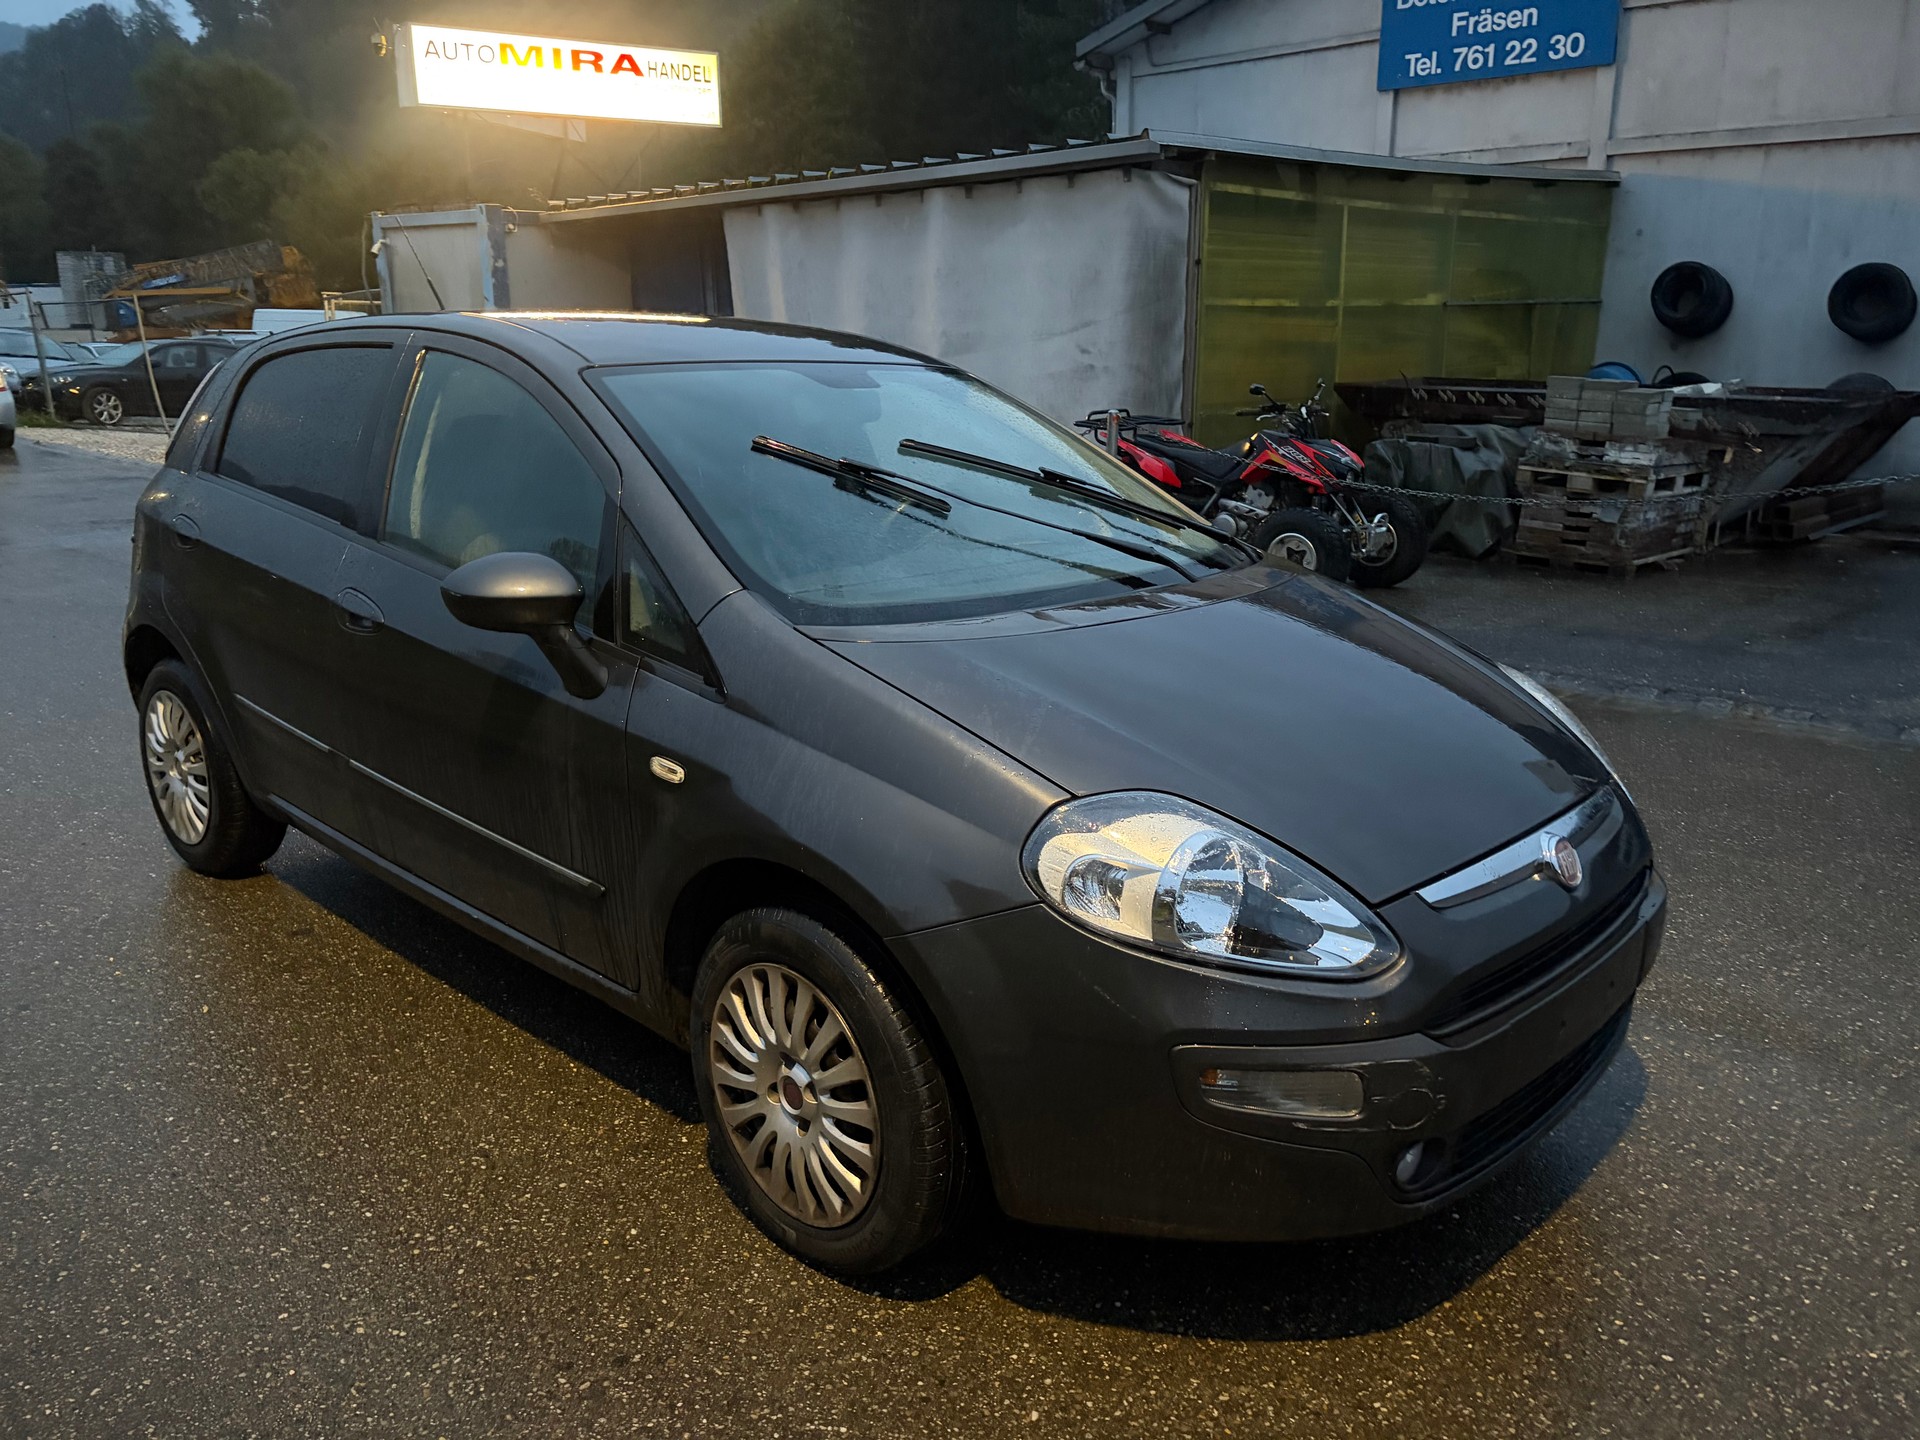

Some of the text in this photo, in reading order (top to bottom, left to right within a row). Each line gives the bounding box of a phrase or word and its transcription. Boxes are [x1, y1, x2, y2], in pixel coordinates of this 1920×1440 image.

[1451, 8, 1538, 36] Fräsen
[1405, 32, 1585, 77] Tel. 761 22 30
